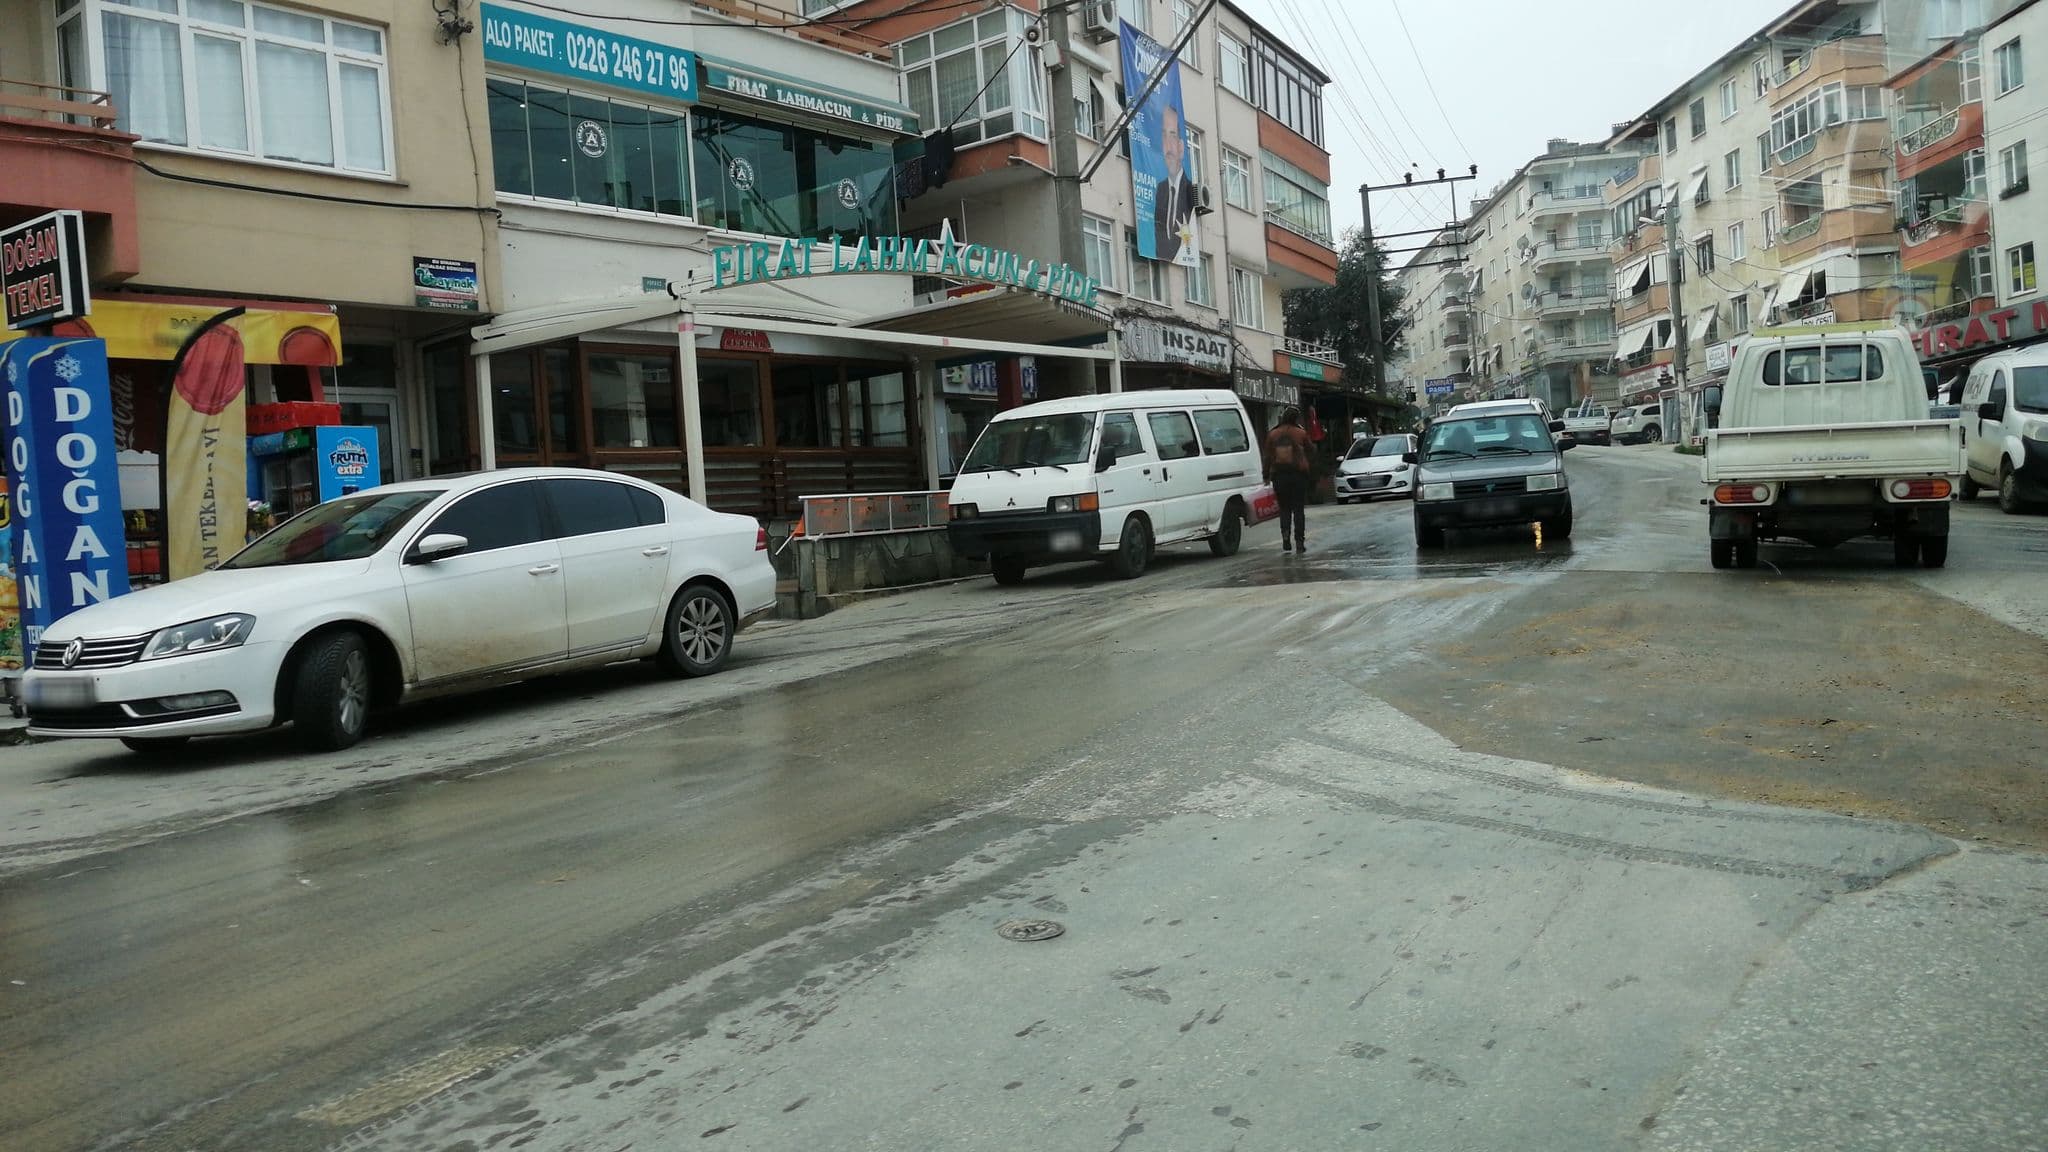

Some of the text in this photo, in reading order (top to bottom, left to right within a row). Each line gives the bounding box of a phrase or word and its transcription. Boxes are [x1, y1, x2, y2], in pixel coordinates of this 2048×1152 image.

[485, 18, 511, 48] ALO
[514, 24, 554, 58] PAKET
[566, 31, 608, 74] 0226
[612, 41, 642, 82] 246
[646, 49, 664, 85] 27
[669, 54, 689, 91] 96
[727, 75, 903, 130] FIRAT LAHMACUN & PİDE
[3, 228, 58, 275] DOĞAN
[712, 236, 817, 289] FIRAT
[1024, 259, 1039, 291] &
[1046, 261, 1099, 307] PİDE
[7, 273, 62, 317] TEKEL
[1162, 326, 1227, 358] İNŞAAT
[54, 387, 110, 606] DOĞAN
[337, 464, 363, 475] extra
[8, 391, 42, 609] DOĞAN
